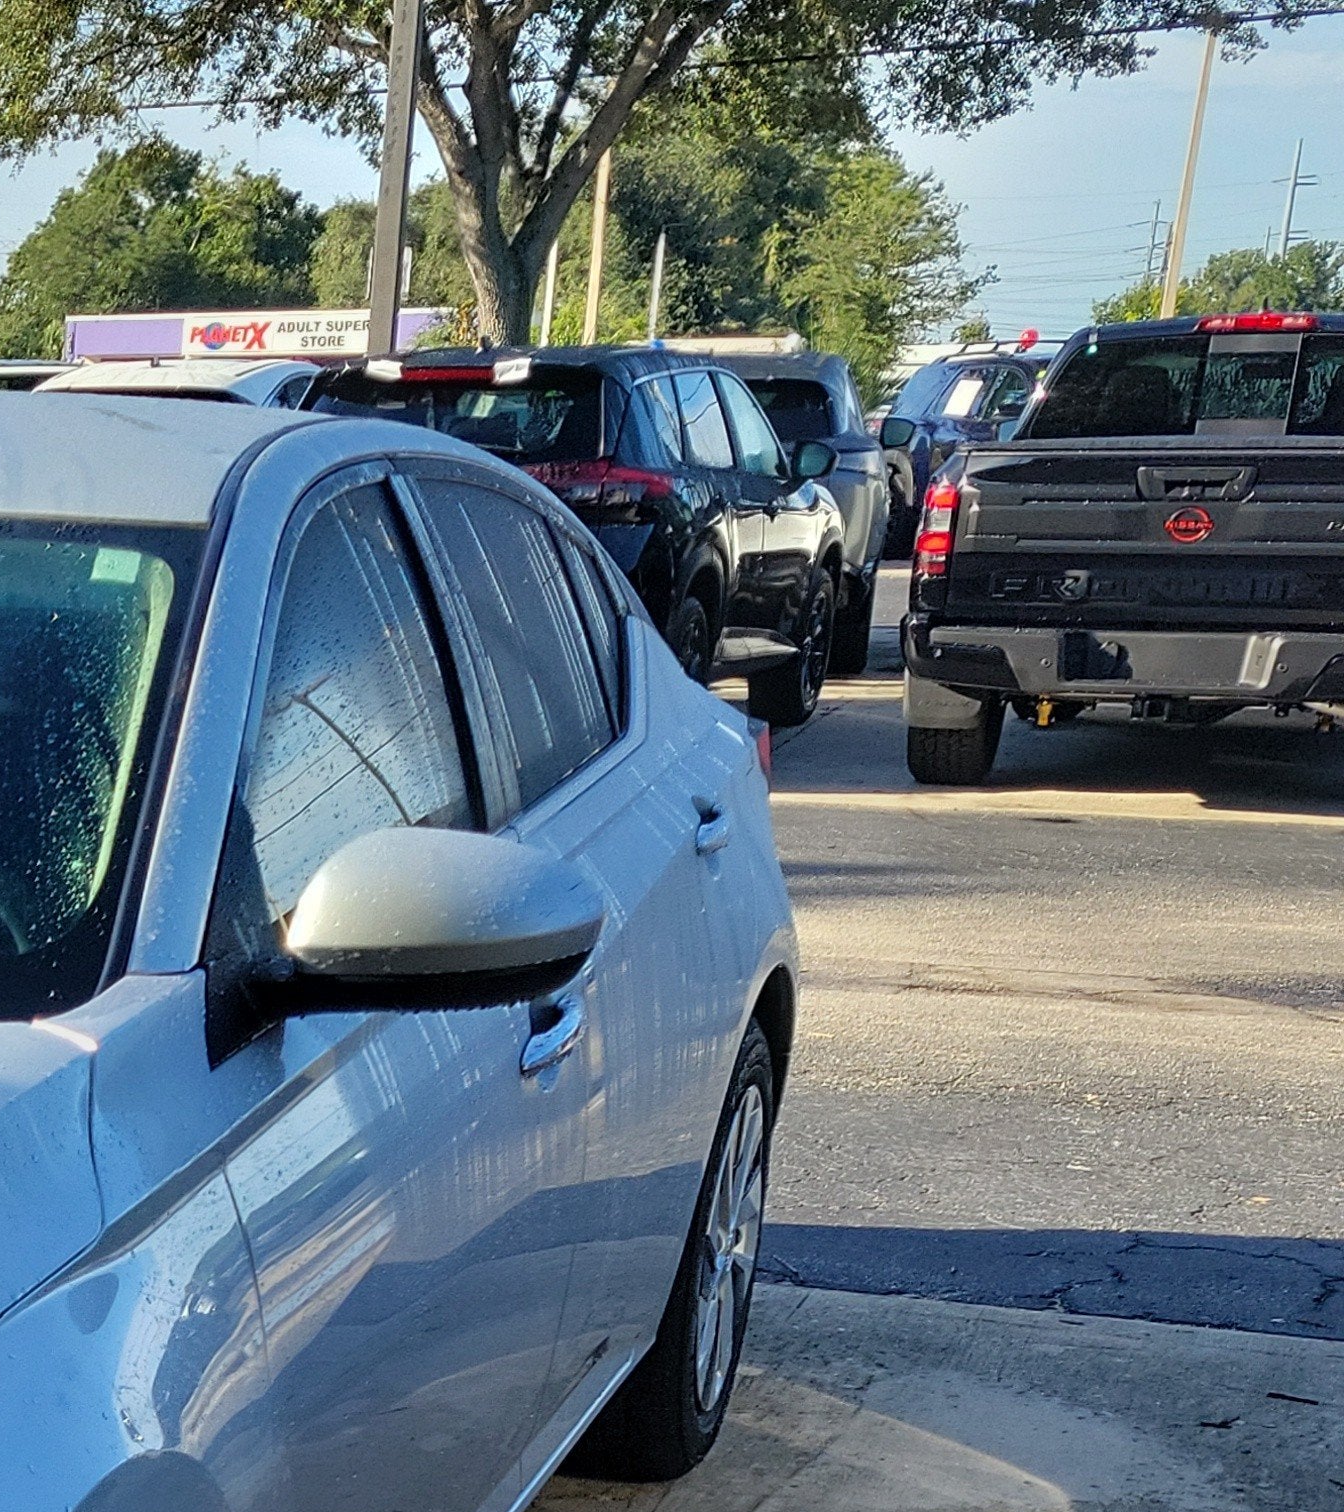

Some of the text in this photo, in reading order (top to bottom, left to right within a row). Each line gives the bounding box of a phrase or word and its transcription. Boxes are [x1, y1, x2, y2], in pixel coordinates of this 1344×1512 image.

[277, 319, 370, 333] ADULT SUPER
[300, 335, 345, 347] STORE
